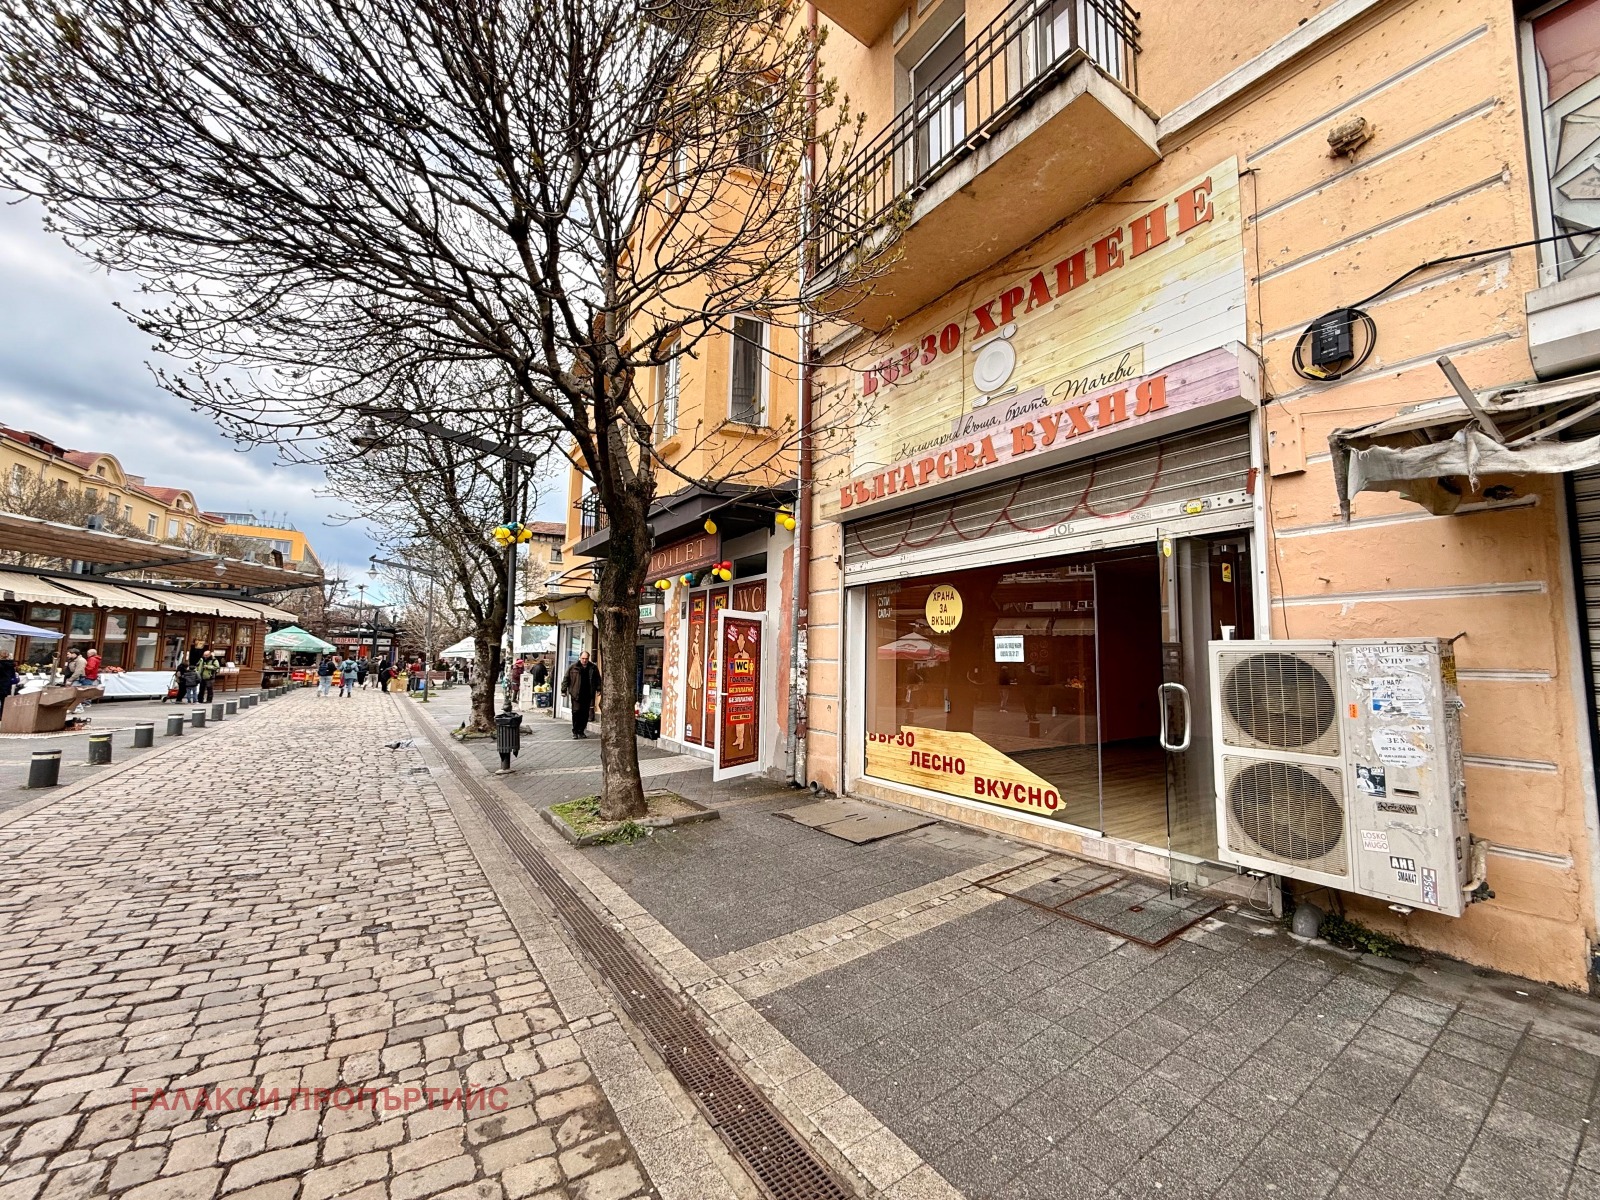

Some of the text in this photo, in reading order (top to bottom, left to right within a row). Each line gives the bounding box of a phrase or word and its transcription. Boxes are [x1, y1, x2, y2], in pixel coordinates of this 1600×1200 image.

[862, 175, 1214, 397] БЪРЗО ХРАНЕНЕ
[1005, 394, 1052, 421] братя
[1052, 352, 1136, 400] Тачеви
[840, 374, 1169, 510] БЪЛГАРСКА КУХНЯ
[651, 538, 706, 572] TOILET
[739, 587, 761, 611] WC
[932, 591, 955, 602] ХРАНА
[939, 603, 948, 613] ЗА
[931, 615, 956, 627] ВКЪЩИ
[736, 661, 748, 670] WC
[910, 751, 965, 775] ЛЕСНО
[974, 776, 1058, 810] ВКУСНО
[1362, 832, 1387, 841] LOSKO
[1364, 841, 1388, 850] MUGO
